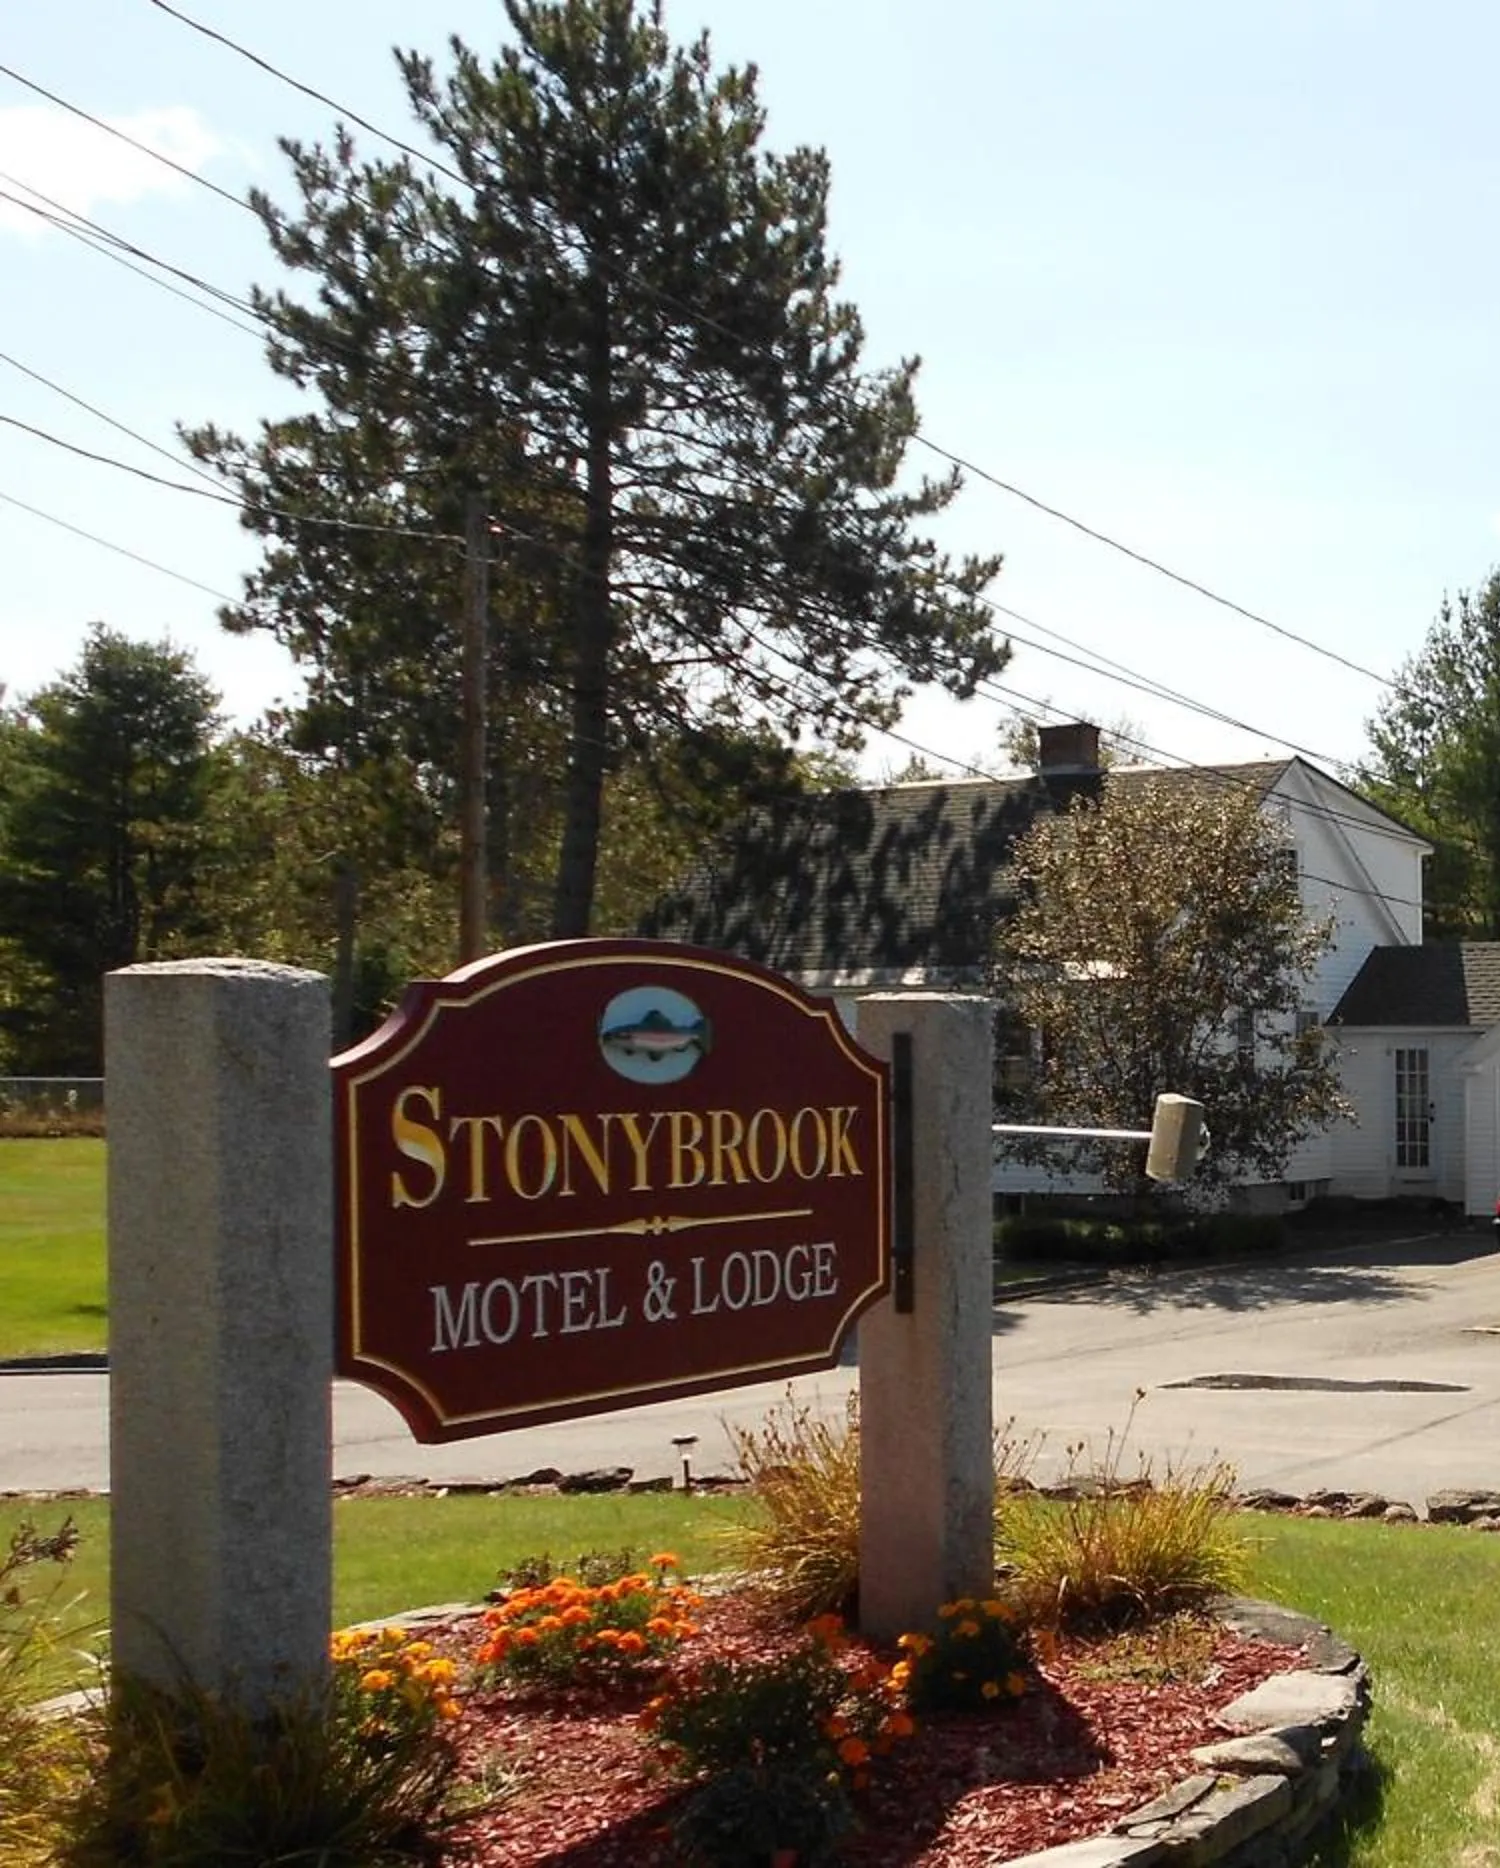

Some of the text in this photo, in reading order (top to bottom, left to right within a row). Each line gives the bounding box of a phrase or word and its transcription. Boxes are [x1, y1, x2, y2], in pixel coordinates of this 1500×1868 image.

[392, 1086, 863, 1209] STONYBROOK
[429, 1242, 838, 1353] MOTEL & LODGE
